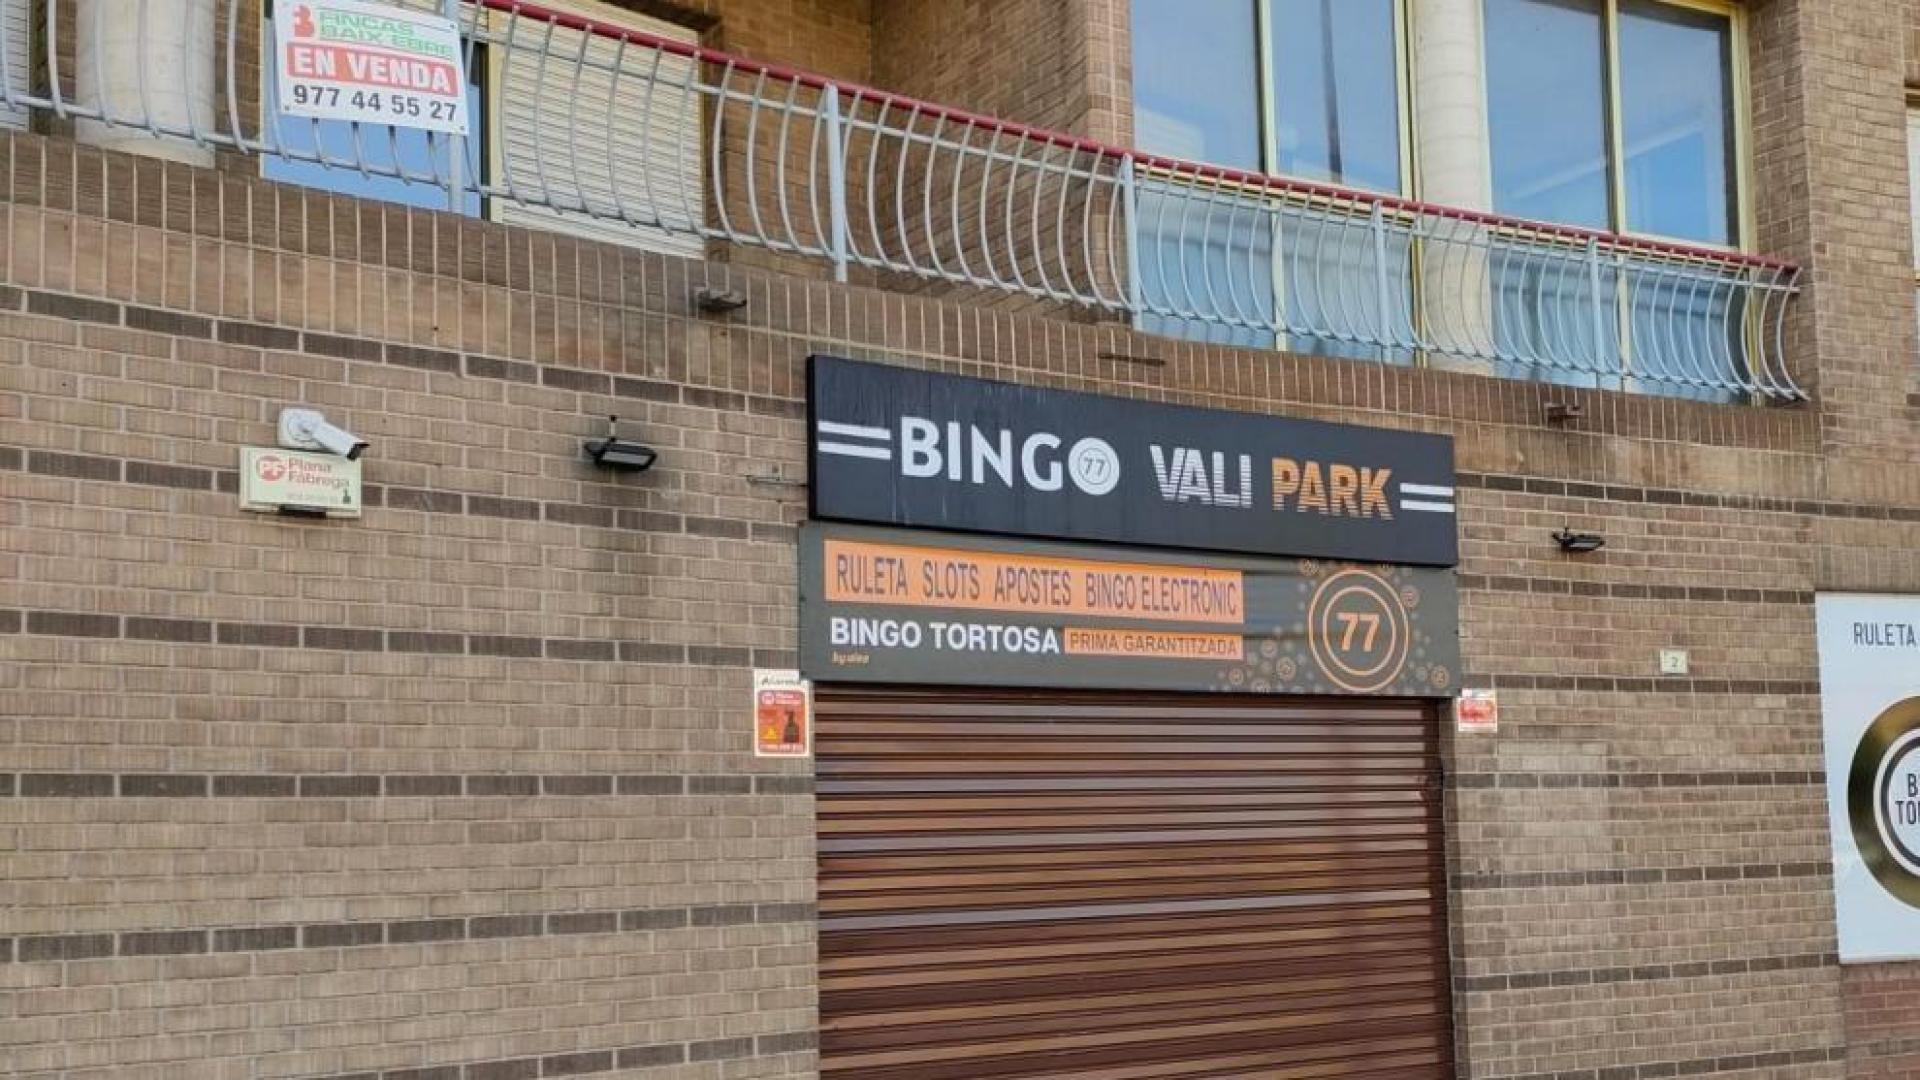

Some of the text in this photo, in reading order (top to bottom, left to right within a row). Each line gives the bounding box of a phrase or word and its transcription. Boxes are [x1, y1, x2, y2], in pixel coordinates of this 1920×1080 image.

[319, 10, 414, 35] FINCAS
[319, 25, 384, 45] BAIX
[294, 47, 451, 93] EN VENDA
[293, 84, 457, 121] 977 44 55 27
[901, 416, 1394, 521] BINGO VALI PARK
[1082, 456, 1105, 477] 77
[837, 553, 908, 596] RULETA
[922, 559, 981, 602] SLOTS
[994, 566, 1072, 607] APOSTES
[1085, 572, 1137, 611] BINGO
[830, 616, 922, 649] BINGO
[929, 620, 1061, 655] TORTOSA
[1069, 632, 1120, 651] PRIMA
[1336, 611, 1381, 653] 77
[1853, 621, 1917, 648] RULETA
[1907, 772, 1920, 798] B
[1894, 800, 1920, 825] TO
